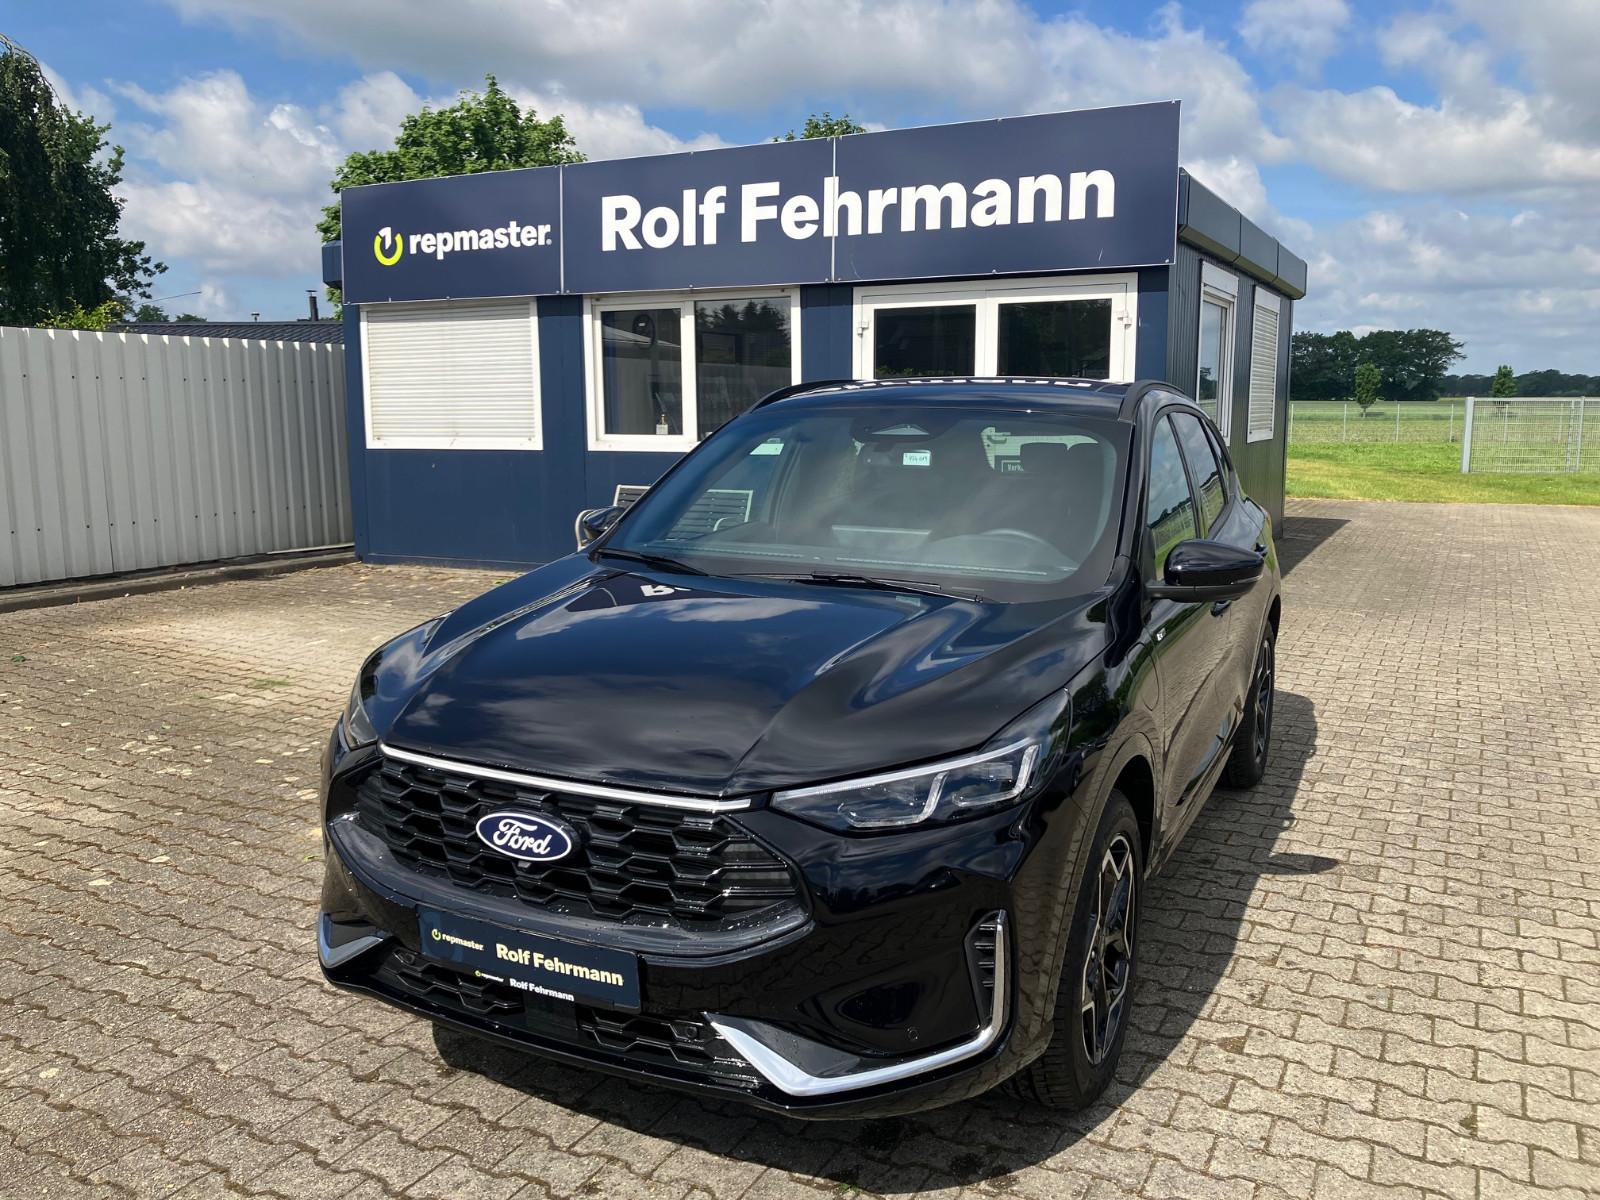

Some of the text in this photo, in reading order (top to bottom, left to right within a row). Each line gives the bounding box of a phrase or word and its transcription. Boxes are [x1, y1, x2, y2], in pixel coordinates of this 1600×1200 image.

[602, 169, 1115, 252] Rolf Fehrmann
[409, 221, 551, 260] repmaster
[493, 818, 552, 855] Ford
[442, 933, 484, 951] repmaster
[496, 943, 624, 987] Rolf Fehrmann
[509, 978, 575, 1002] Rolf Fehrmann
